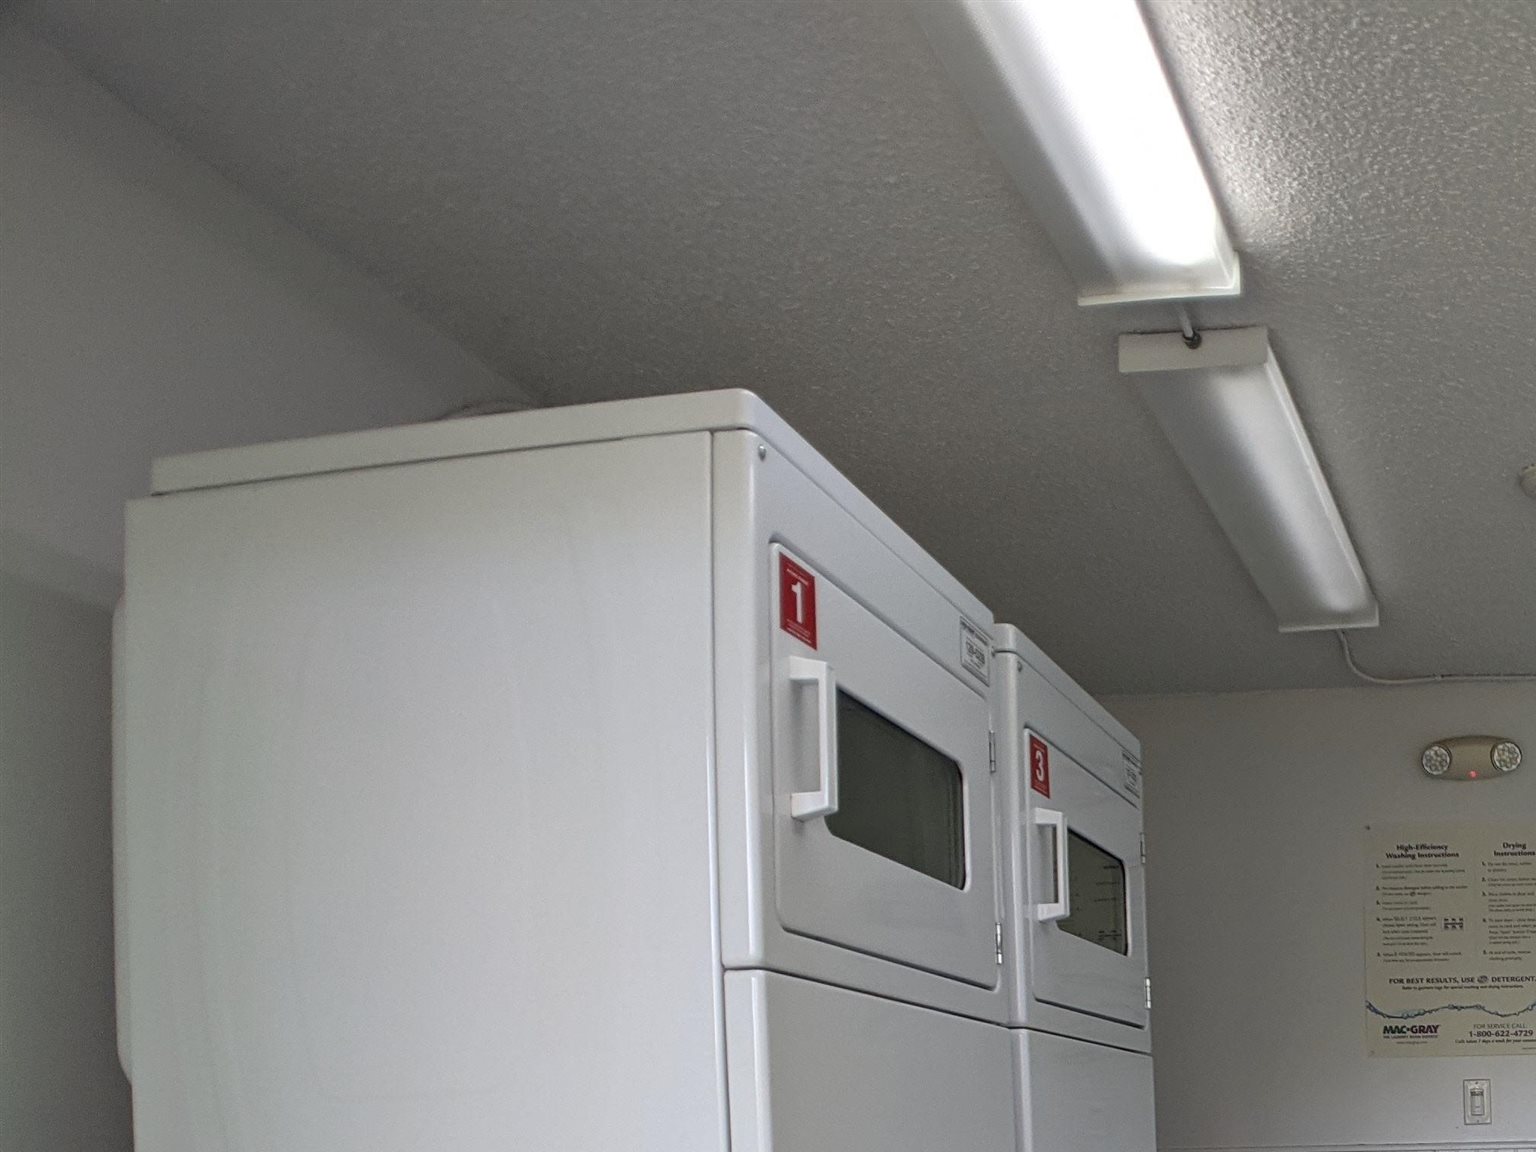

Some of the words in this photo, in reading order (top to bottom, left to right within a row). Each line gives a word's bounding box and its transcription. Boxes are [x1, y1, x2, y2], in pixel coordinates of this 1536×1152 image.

[791, 581, 803, 624] 1
[1035, 750, 1044, 781] 3
[1503, 842, 1527, 850] Drying
[1385, 852, 1416, 860] Washing
[1469, 1030, 1534, 1038] 1-800-622-4729
